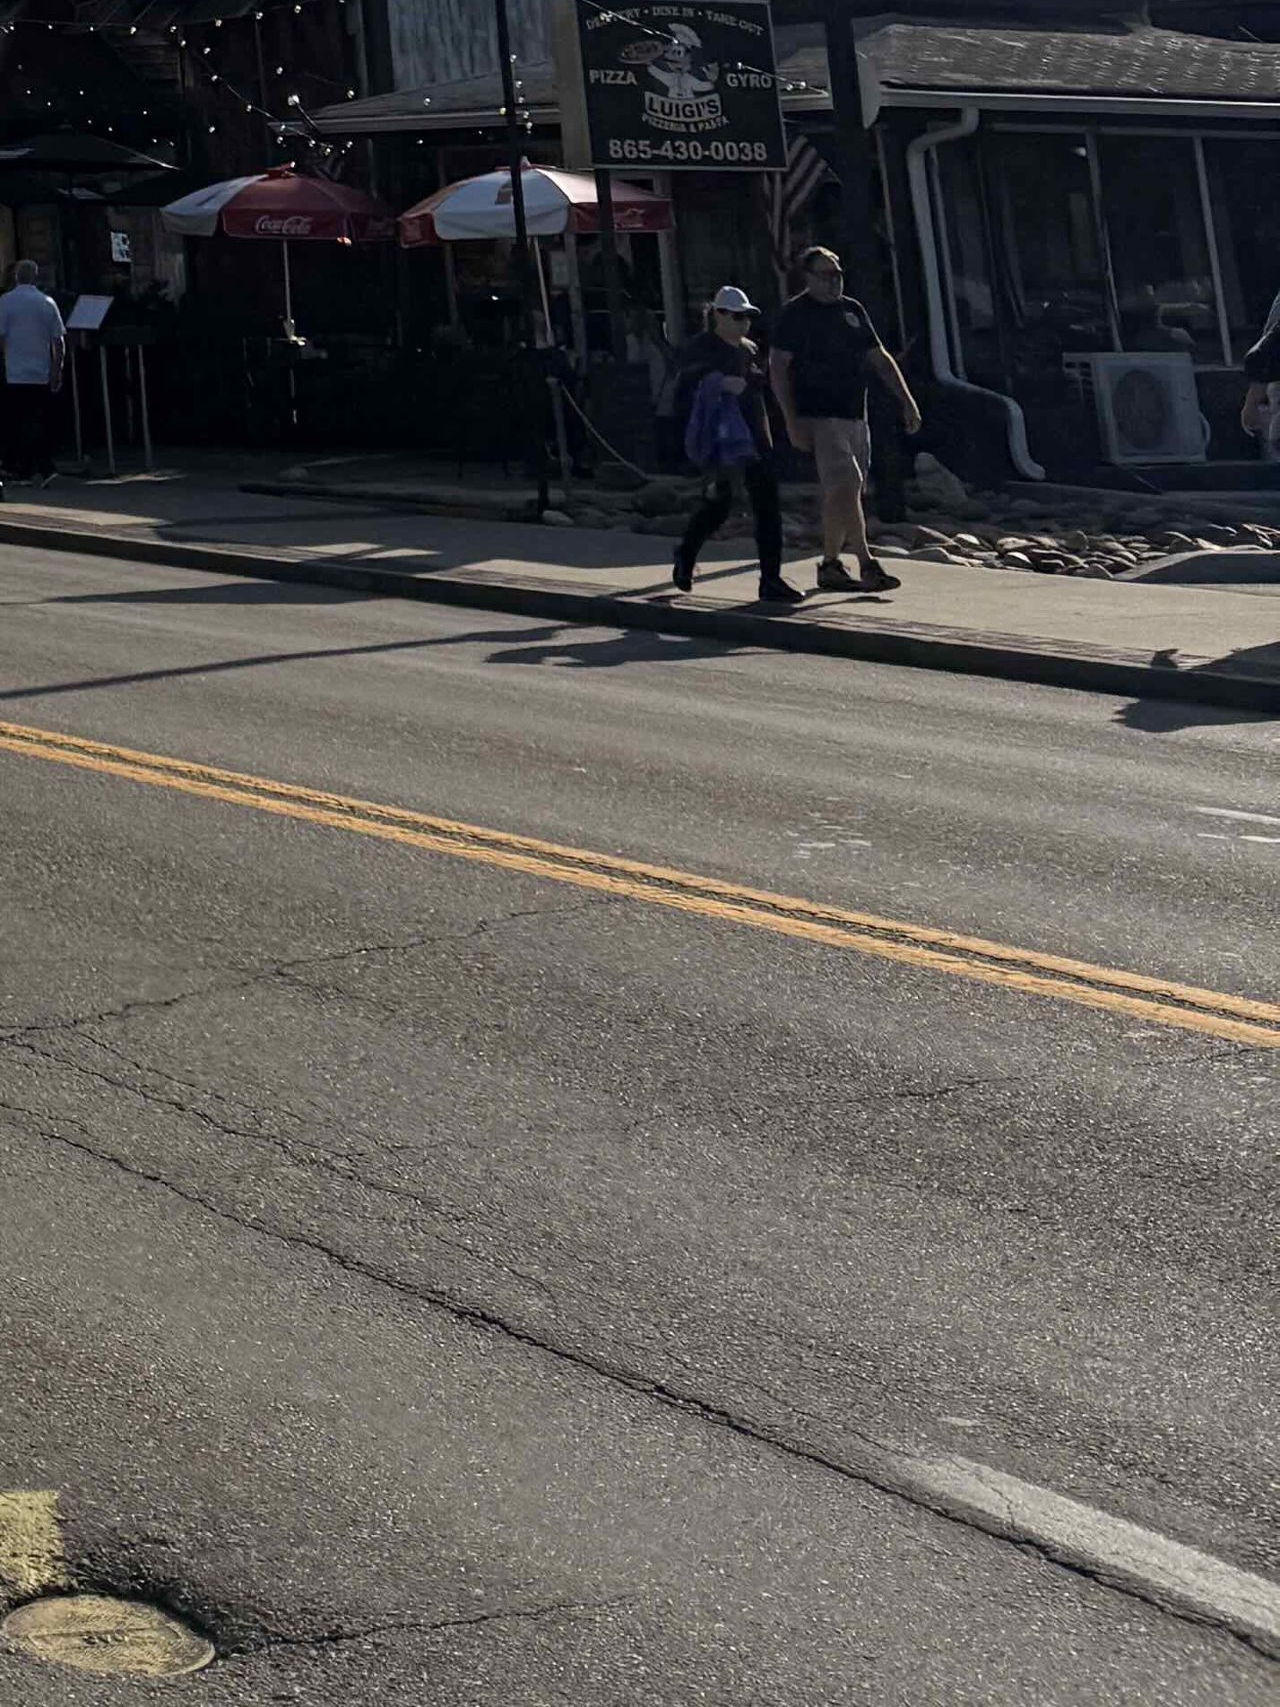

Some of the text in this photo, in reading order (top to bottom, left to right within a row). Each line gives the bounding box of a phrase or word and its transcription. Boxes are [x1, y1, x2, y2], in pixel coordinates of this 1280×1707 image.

[589, 69, 639, 87] PIZZA
[726, 72, 773, 89] GYRO
[648, 96, 720, 119] LUIGI'S
[608, 139, 768, 162] 865-430-0038
